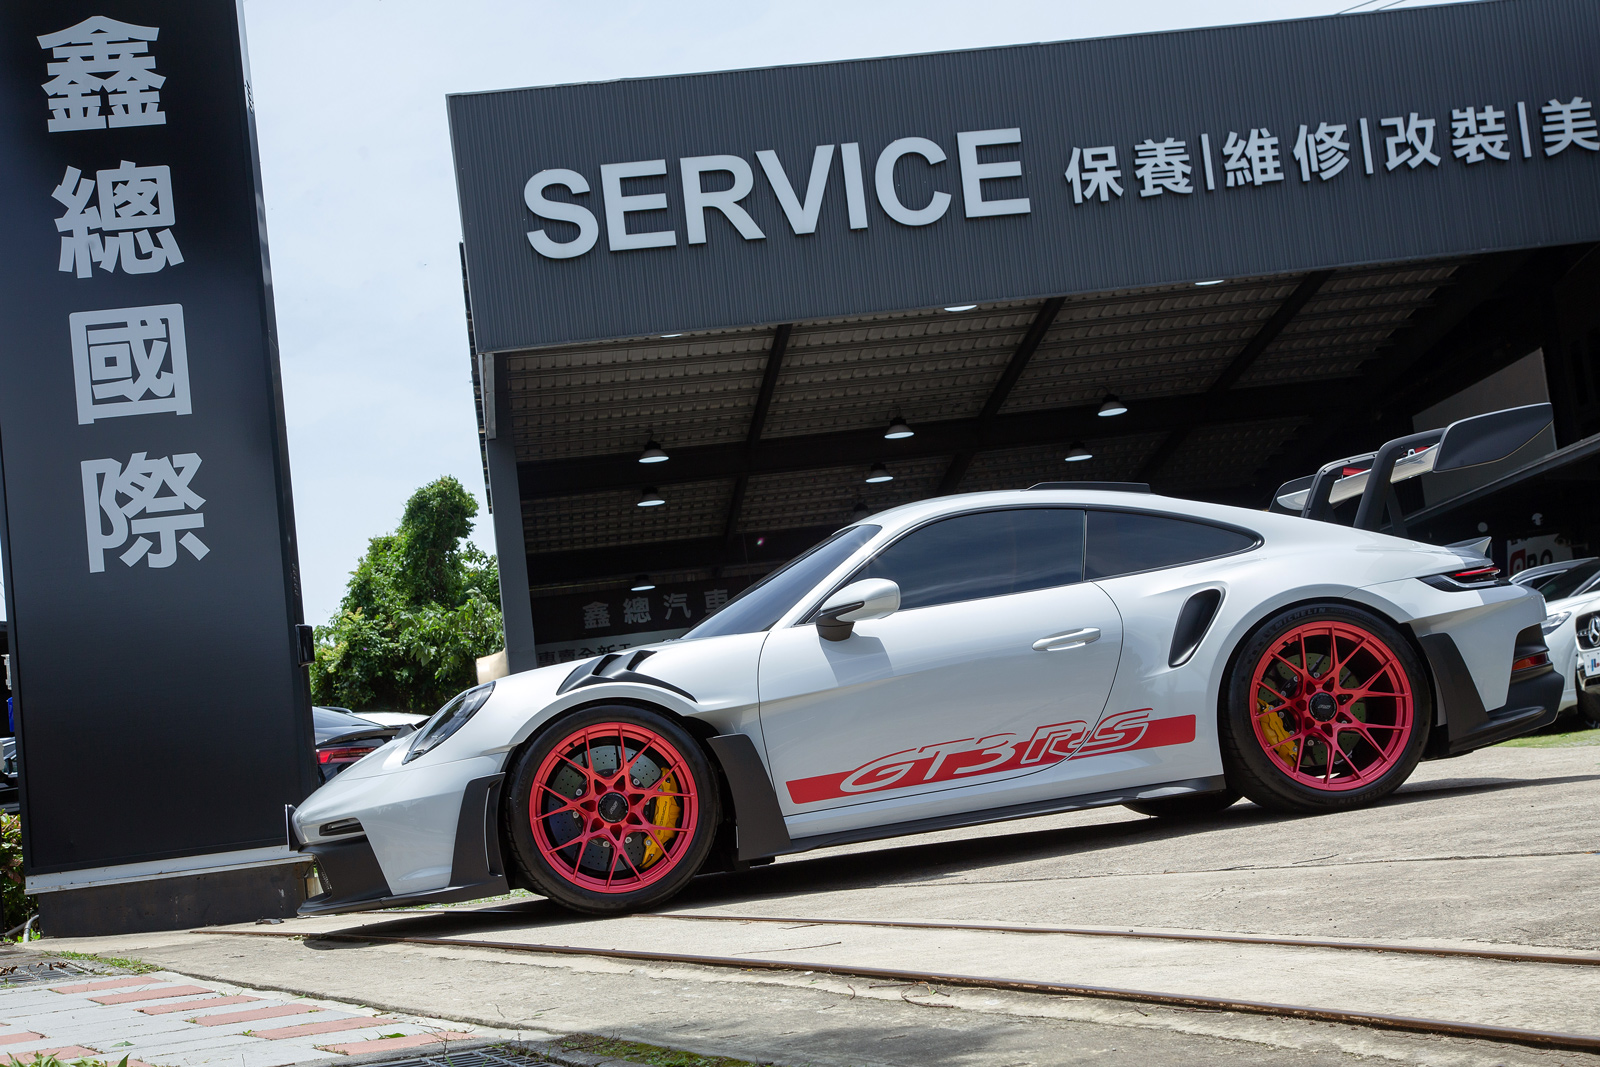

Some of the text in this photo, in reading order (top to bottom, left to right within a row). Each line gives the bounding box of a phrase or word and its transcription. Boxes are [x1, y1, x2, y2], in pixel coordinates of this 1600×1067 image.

[523, 127, 1031, 259] SERVICE
[36, 15, 210, 573] 鑫總國際
[582, 588, 729, 629] 鑫總汽車
[1274, 607, 1326, 630] MICHELIN
[657, 800, 668, 836] PORSCE
